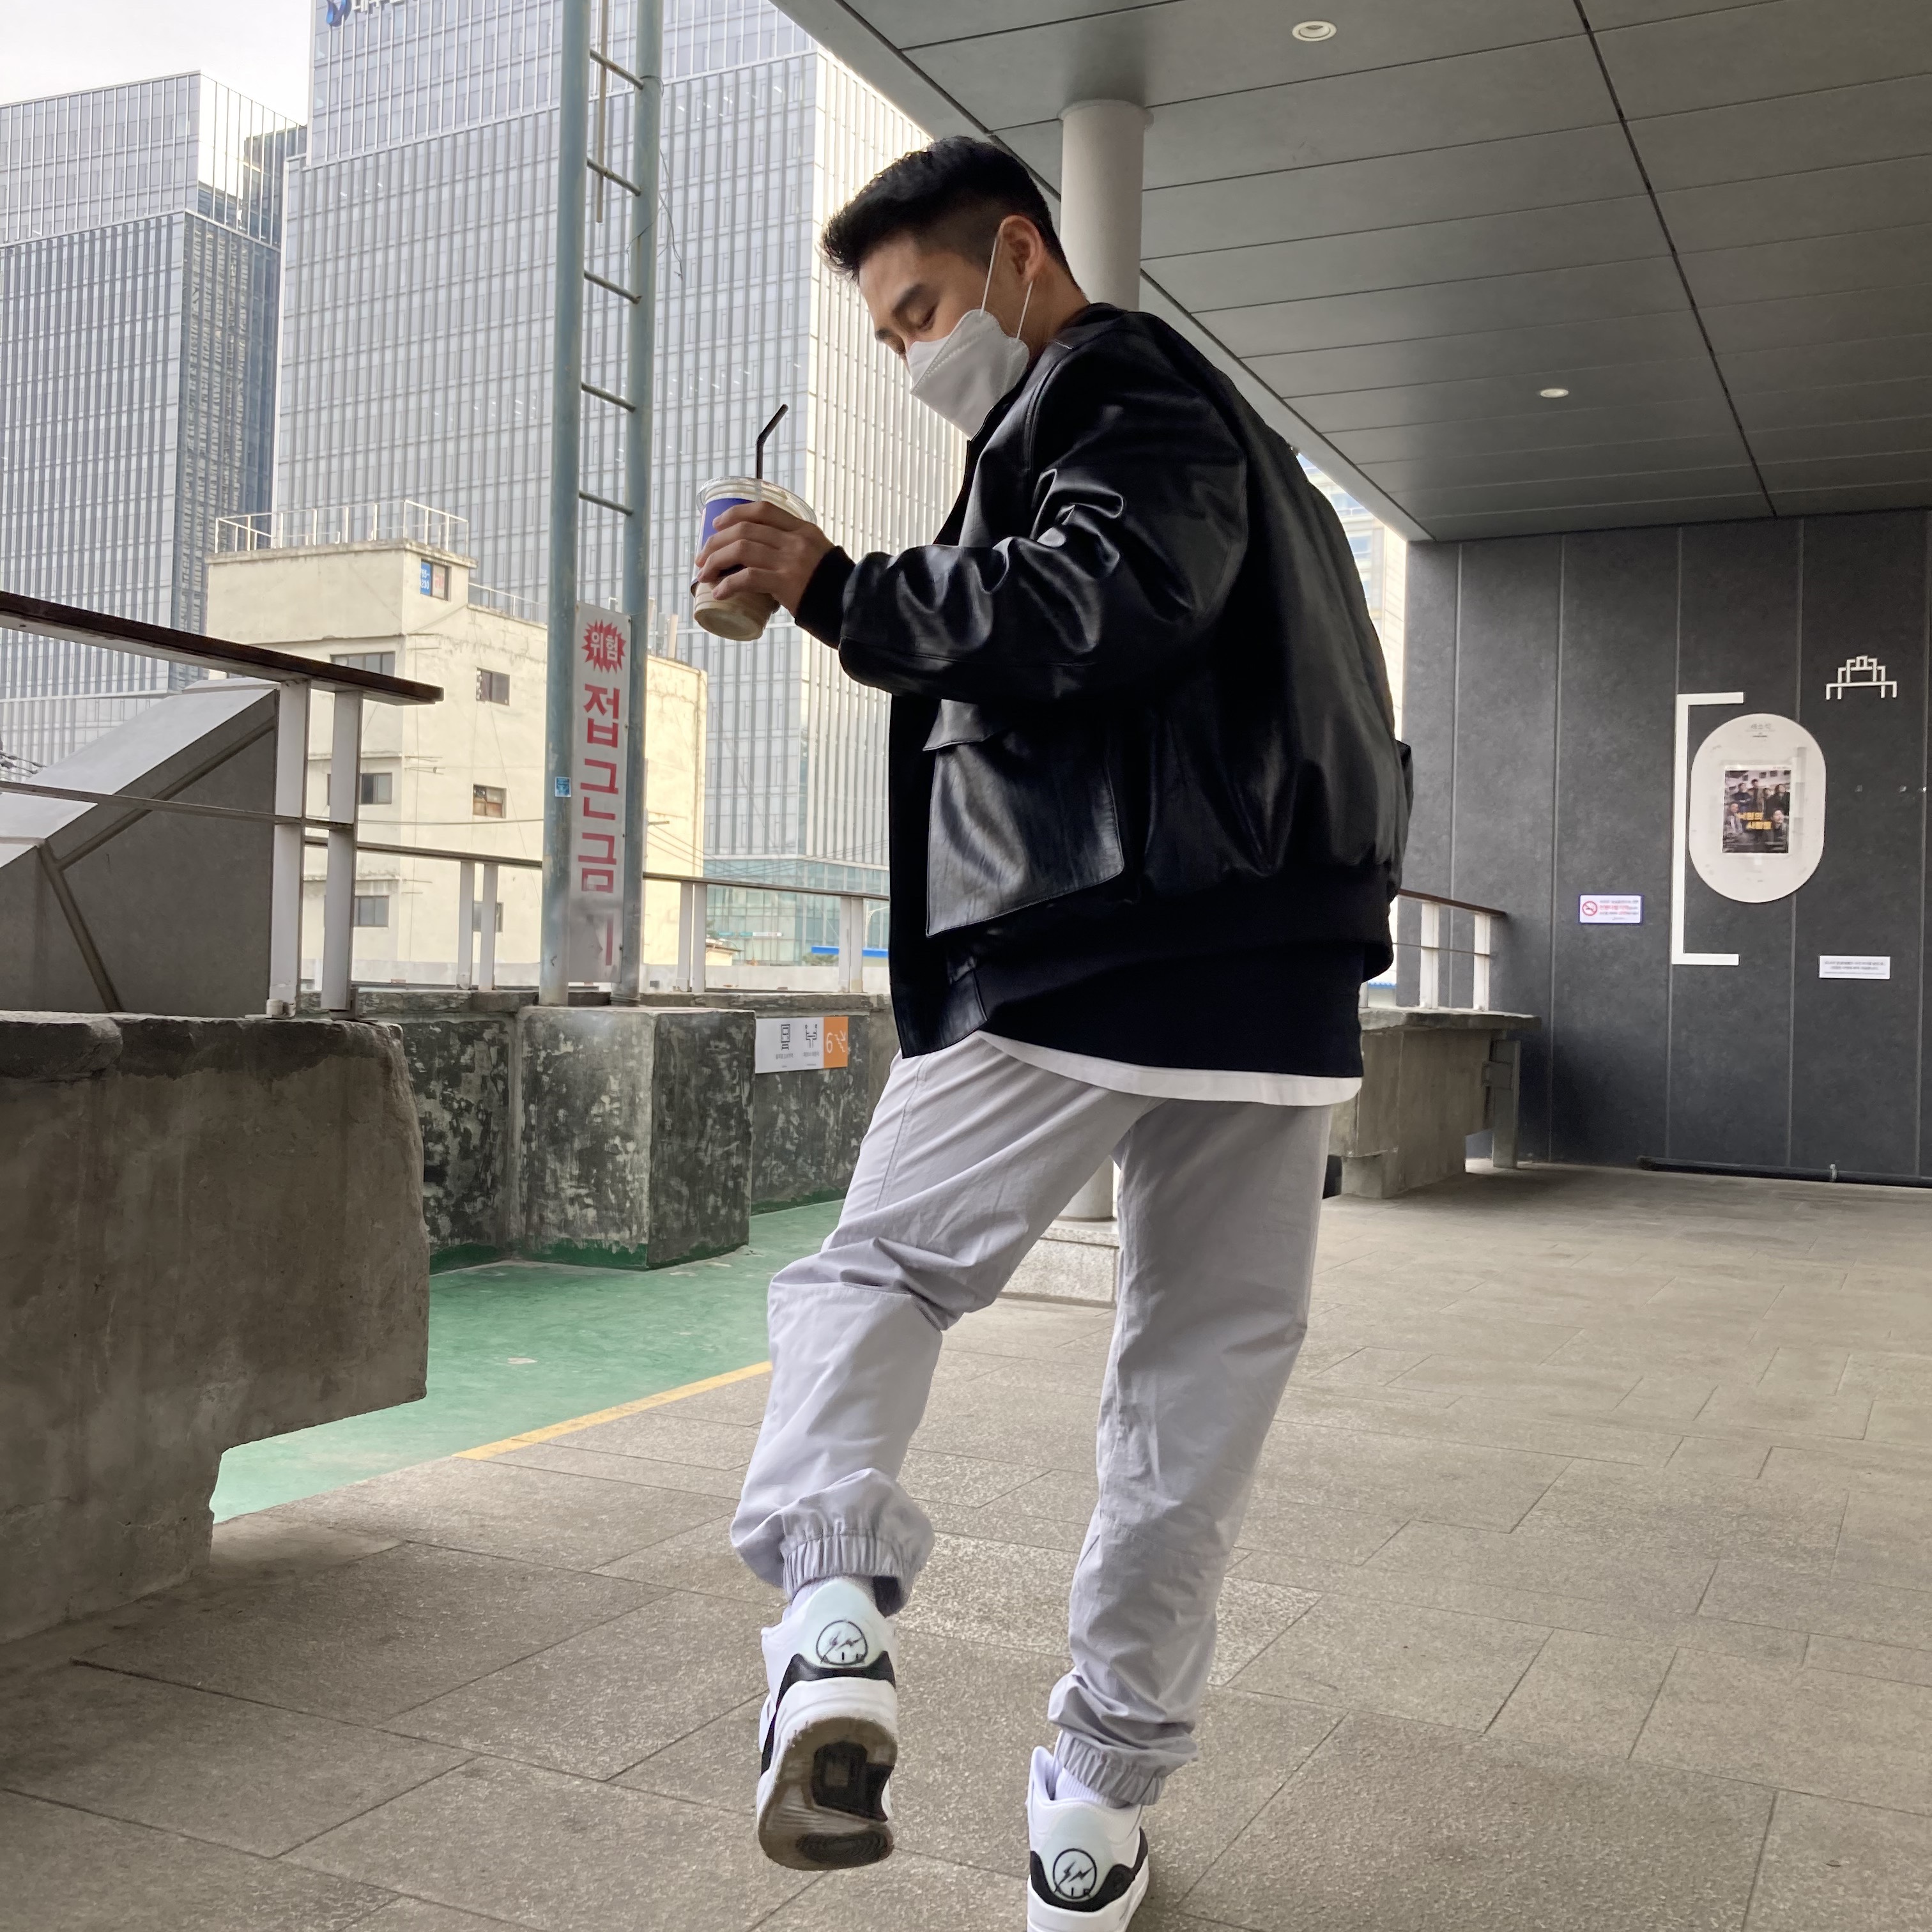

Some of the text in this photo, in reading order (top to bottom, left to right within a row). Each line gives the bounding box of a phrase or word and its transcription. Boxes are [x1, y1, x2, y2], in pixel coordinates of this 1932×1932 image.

[420, 579, 430, 590] 230
[590, 632, 618, 662] 위험
[826, 1032, 833, 1054] 6
